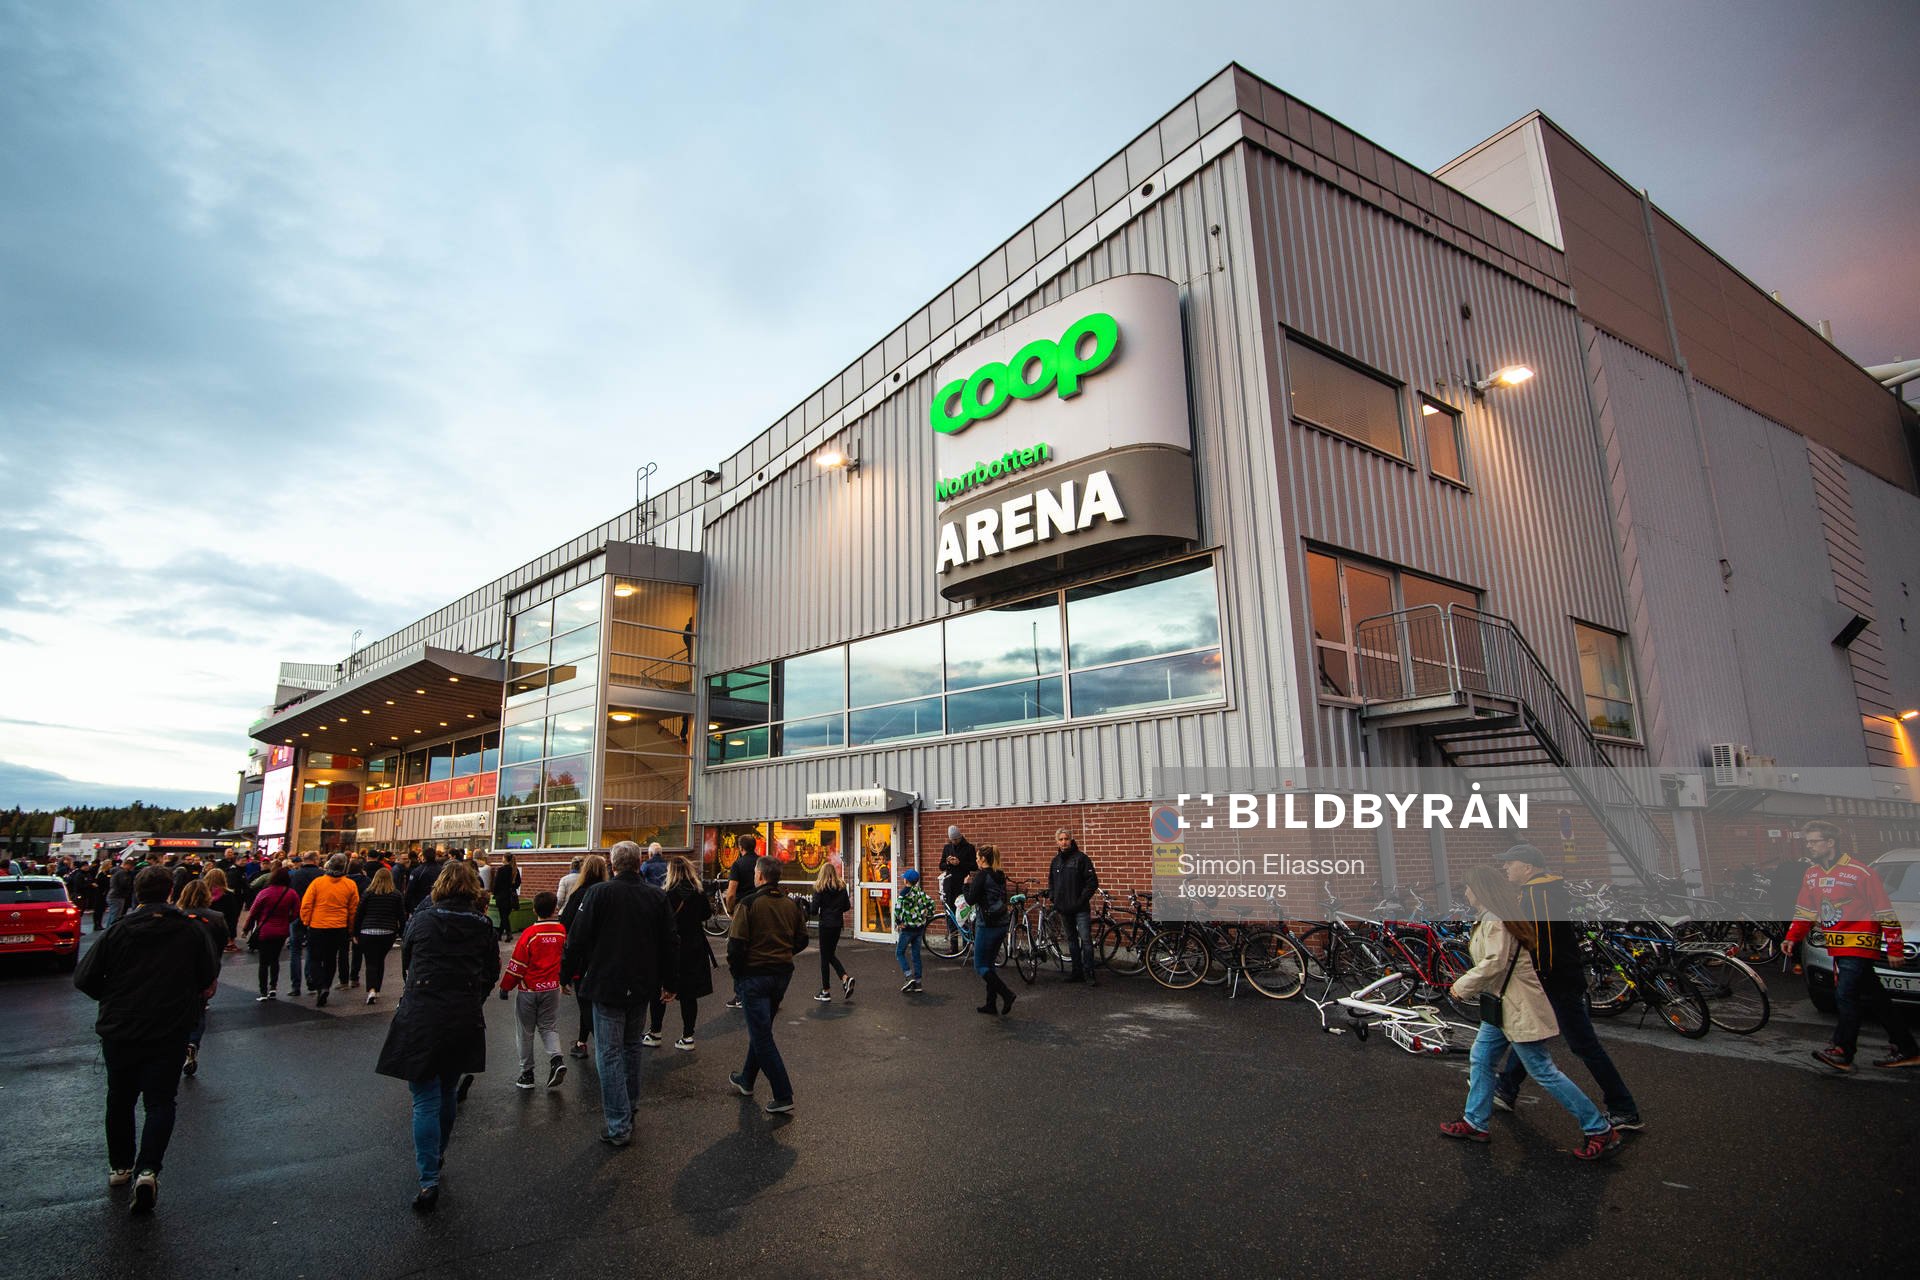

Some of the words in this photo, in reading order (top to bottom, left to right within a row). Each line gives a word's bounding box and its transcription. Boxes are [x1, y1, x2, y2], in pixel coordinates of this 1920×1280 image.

[930, 312, 1121, 434] coop
[935, 442, 1051, 502] Norrbotten
[936, 470, 1126, 574] ARENA
[1883, 977, 1912, 990] YGT
